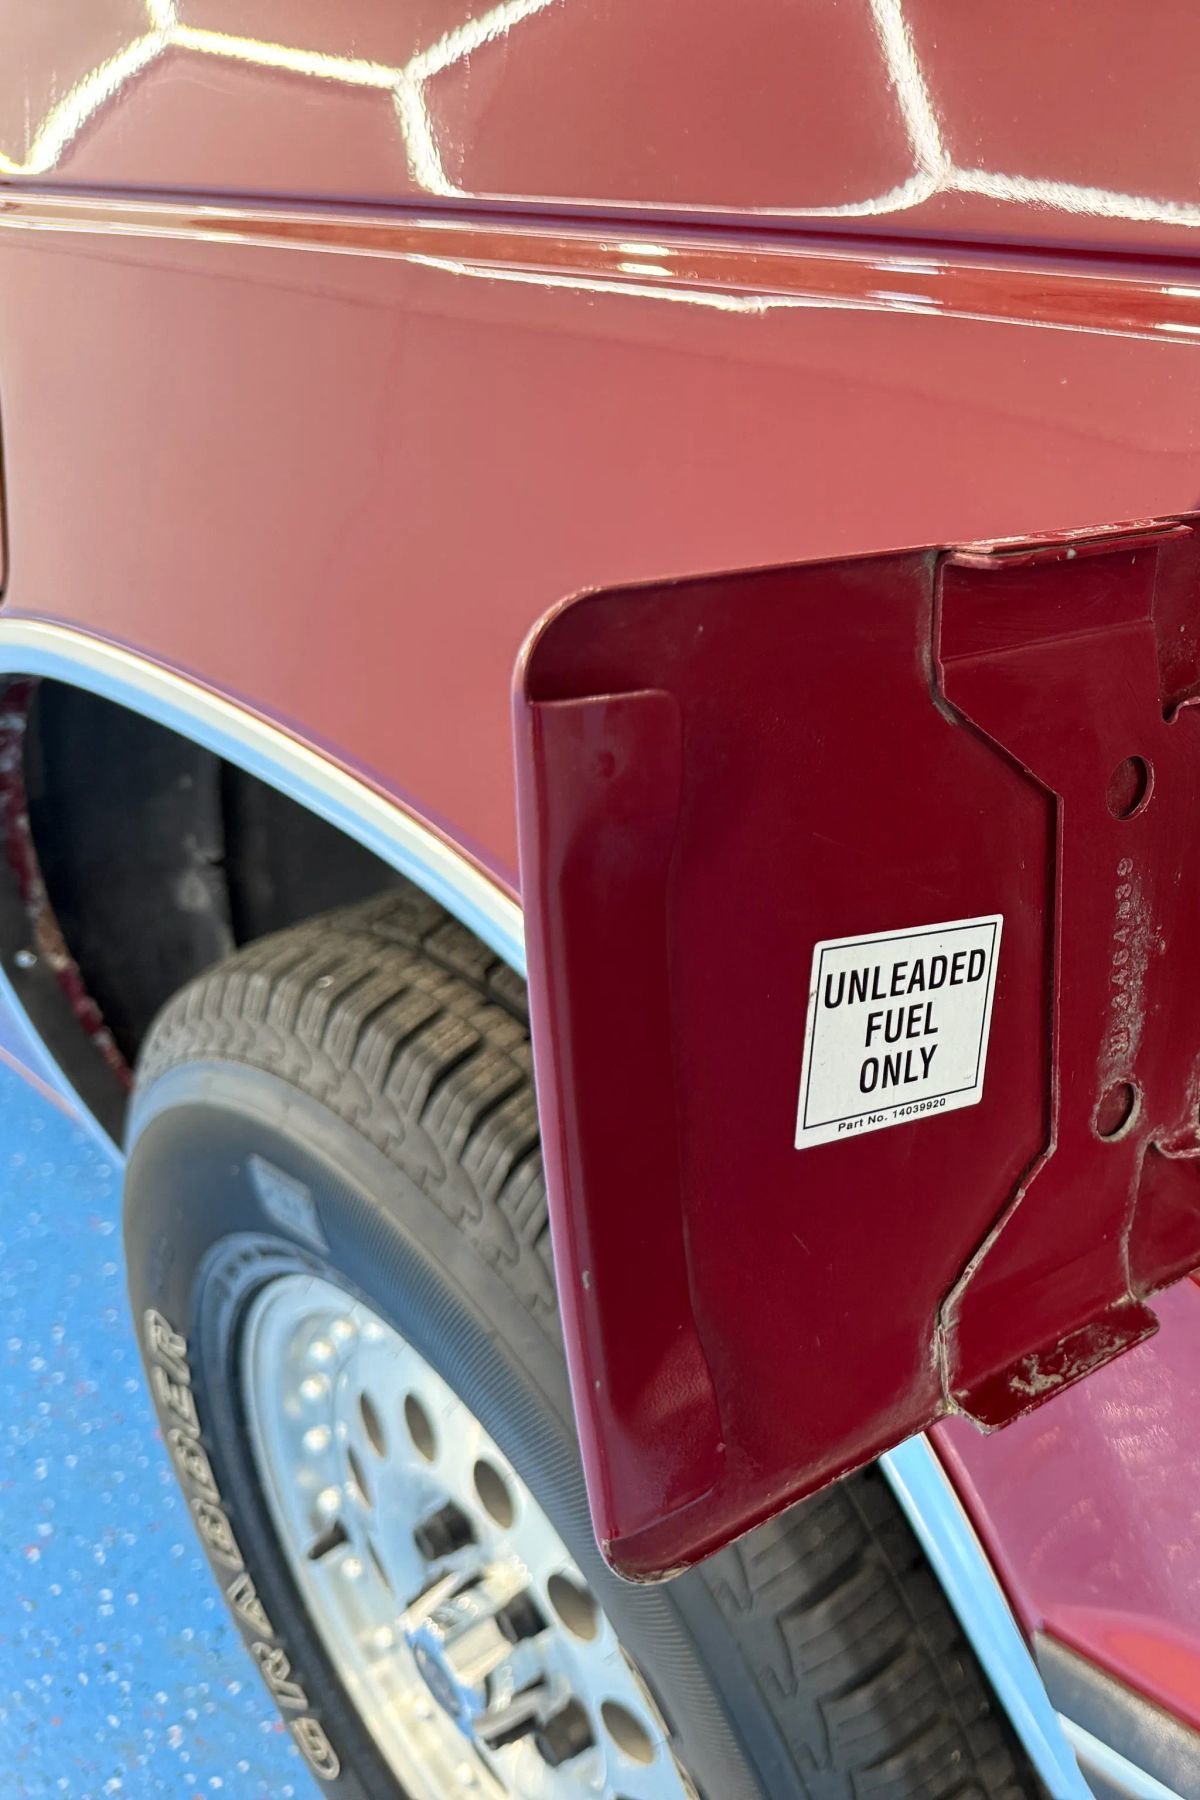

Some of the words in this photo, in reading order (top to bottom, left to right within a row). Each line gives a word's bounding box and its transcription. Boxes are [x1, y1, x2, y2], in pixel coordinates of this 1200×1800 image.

[823, 948, 986, 1009] UNLEADED
[864, 1001, 939, 1048] FUEL
[859, 1044, 939, 1094] ONLY
[837, 1117, 863, 1133] Part
[867, 1112, 888, 1126] No.
[892, 1097, 947, 1119] 14039920
[143, 1308, 341, 1781] GRABBER
